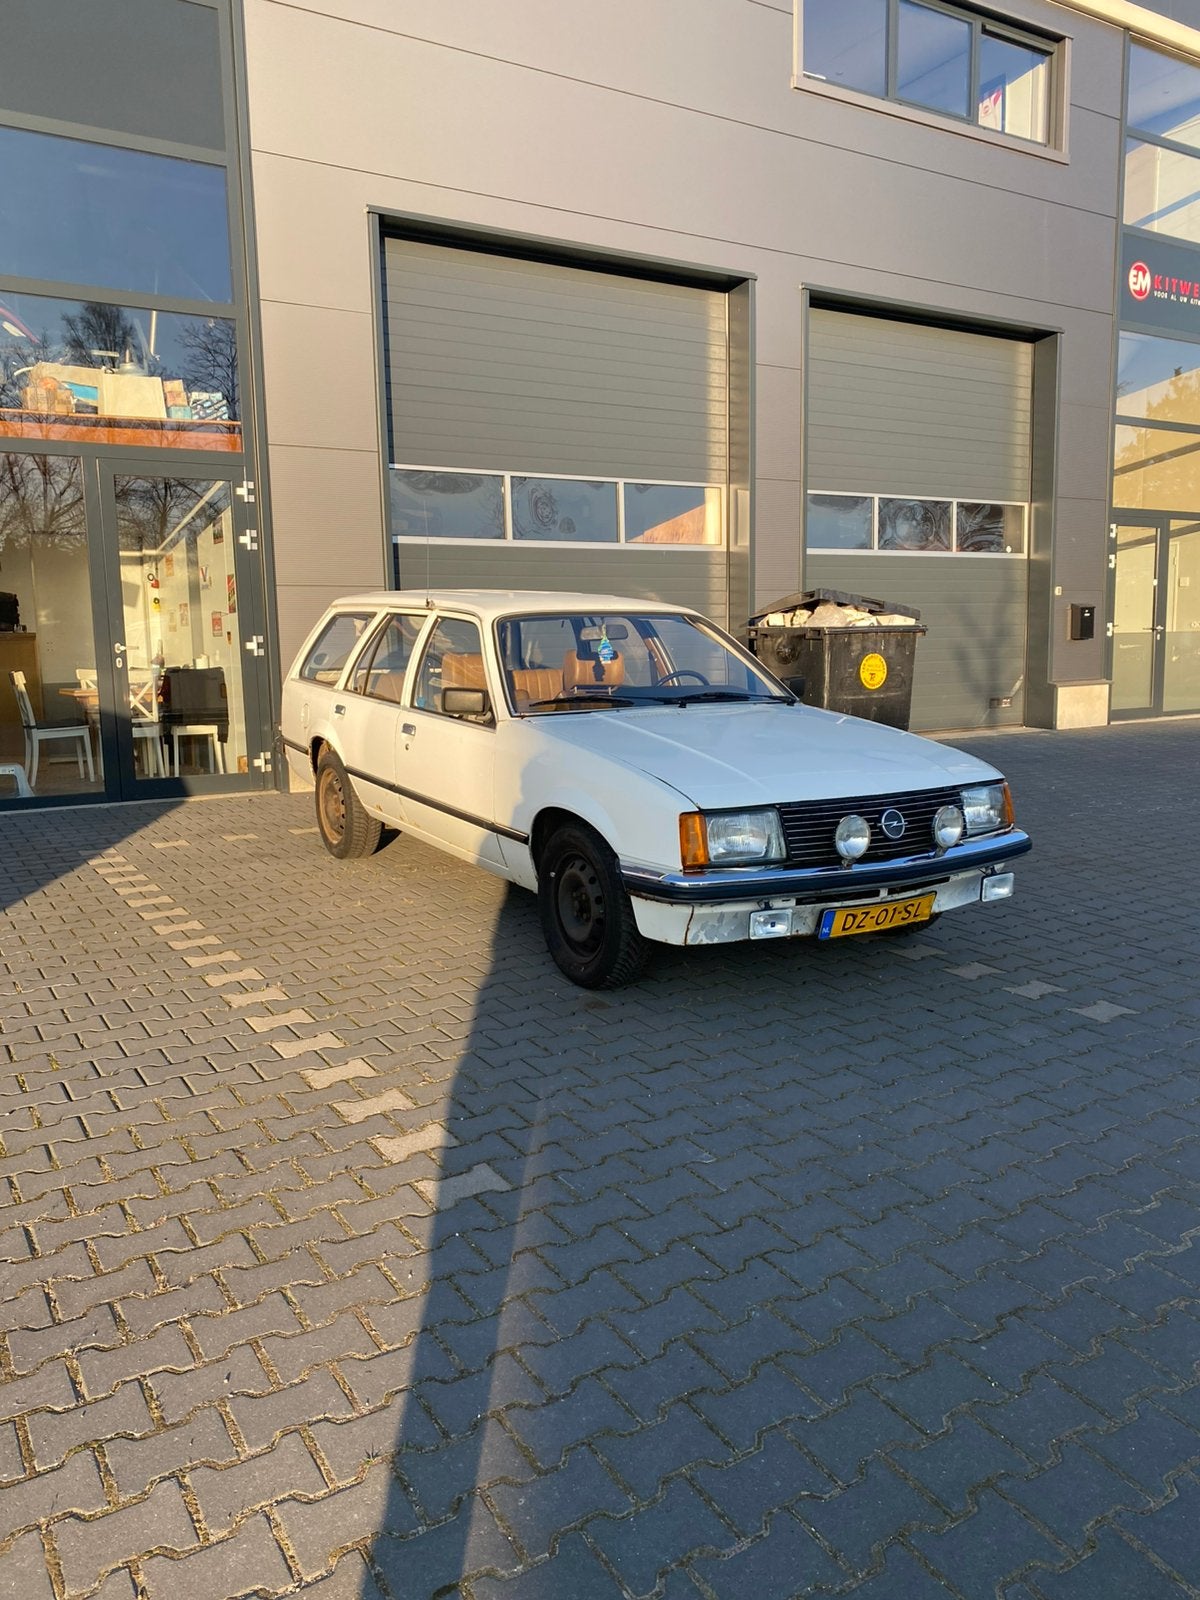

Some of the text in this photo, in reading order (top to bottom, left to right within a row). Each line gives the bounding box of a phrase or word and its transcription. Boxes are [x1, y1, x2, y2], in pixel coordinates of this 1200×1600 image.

[1154, 275, 1199, 298] KITWE
[1154, 290, 1168, 299] VOOR
[841, 901, 922, 932] DZ-01-SL
